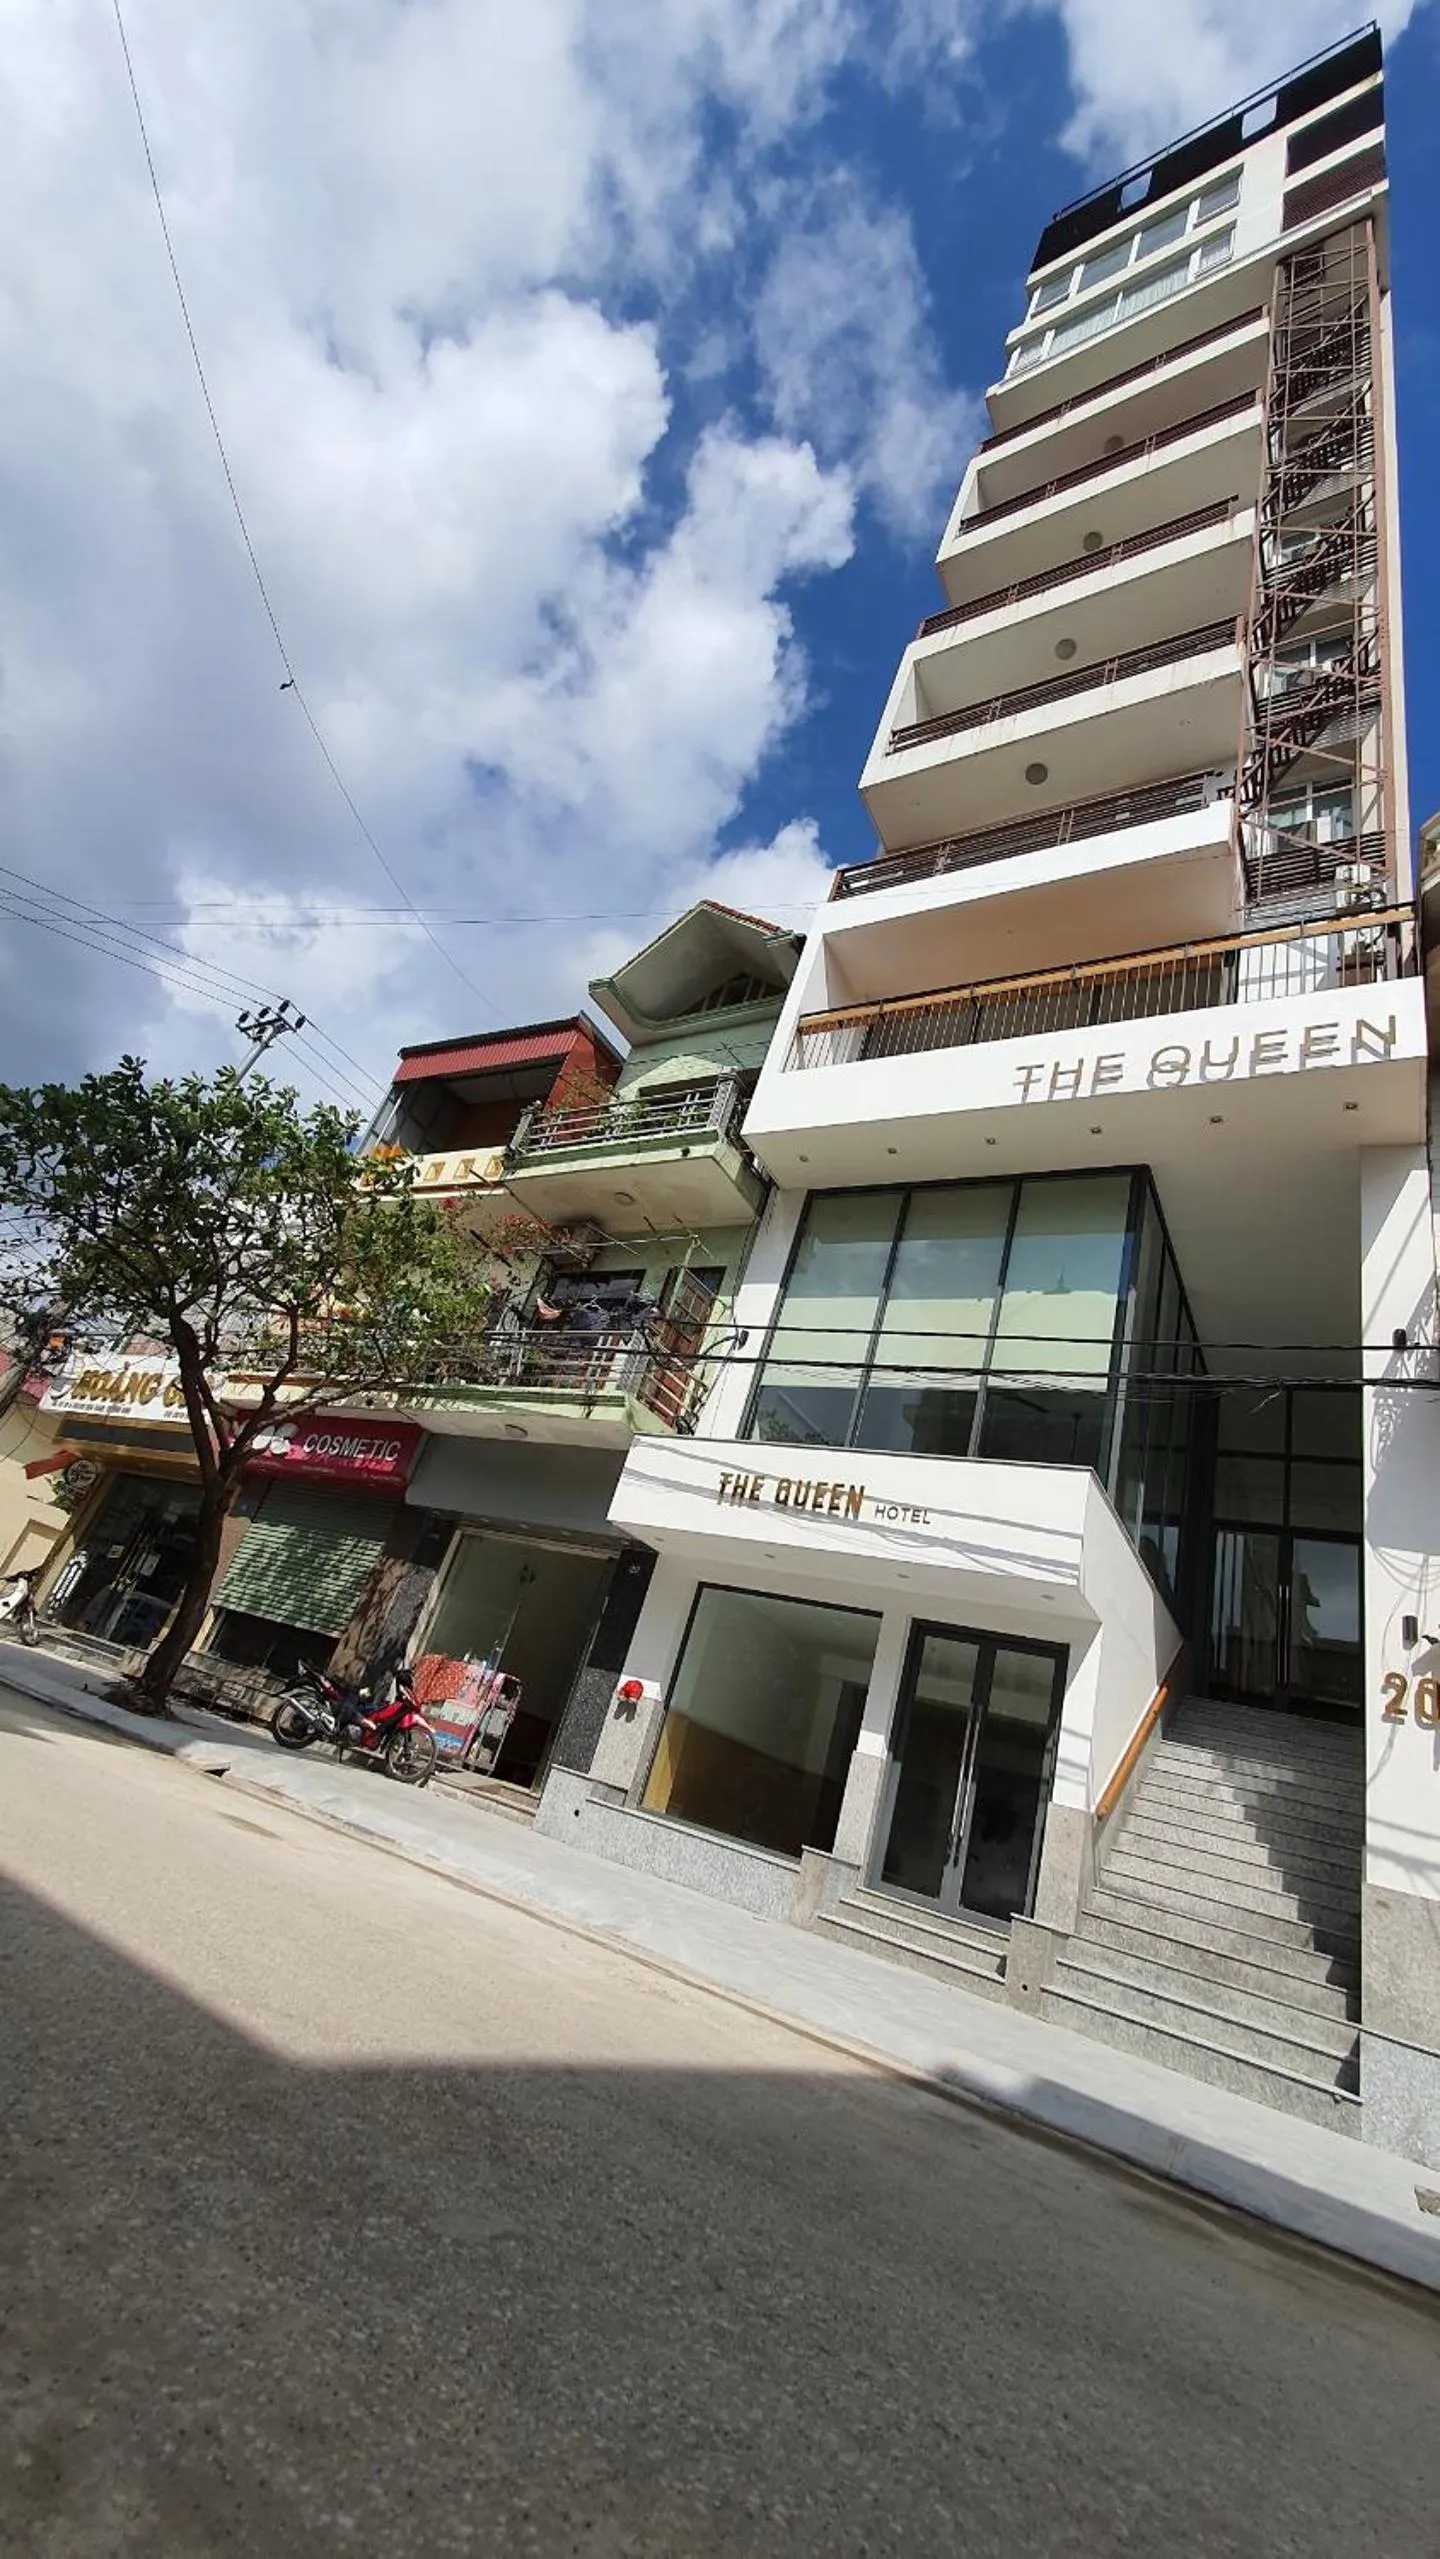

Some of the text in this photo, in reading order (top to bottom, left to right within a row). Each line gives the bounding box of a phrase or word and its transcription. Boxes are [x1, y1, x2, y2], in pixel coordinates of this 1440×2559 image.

[1014, 1014, 1396, 1098] THE QUEEN
[303, 1433, 401, 1461] COSMETIC
[718, 1471, 931, 1525] THE QUEEN HOTEL
